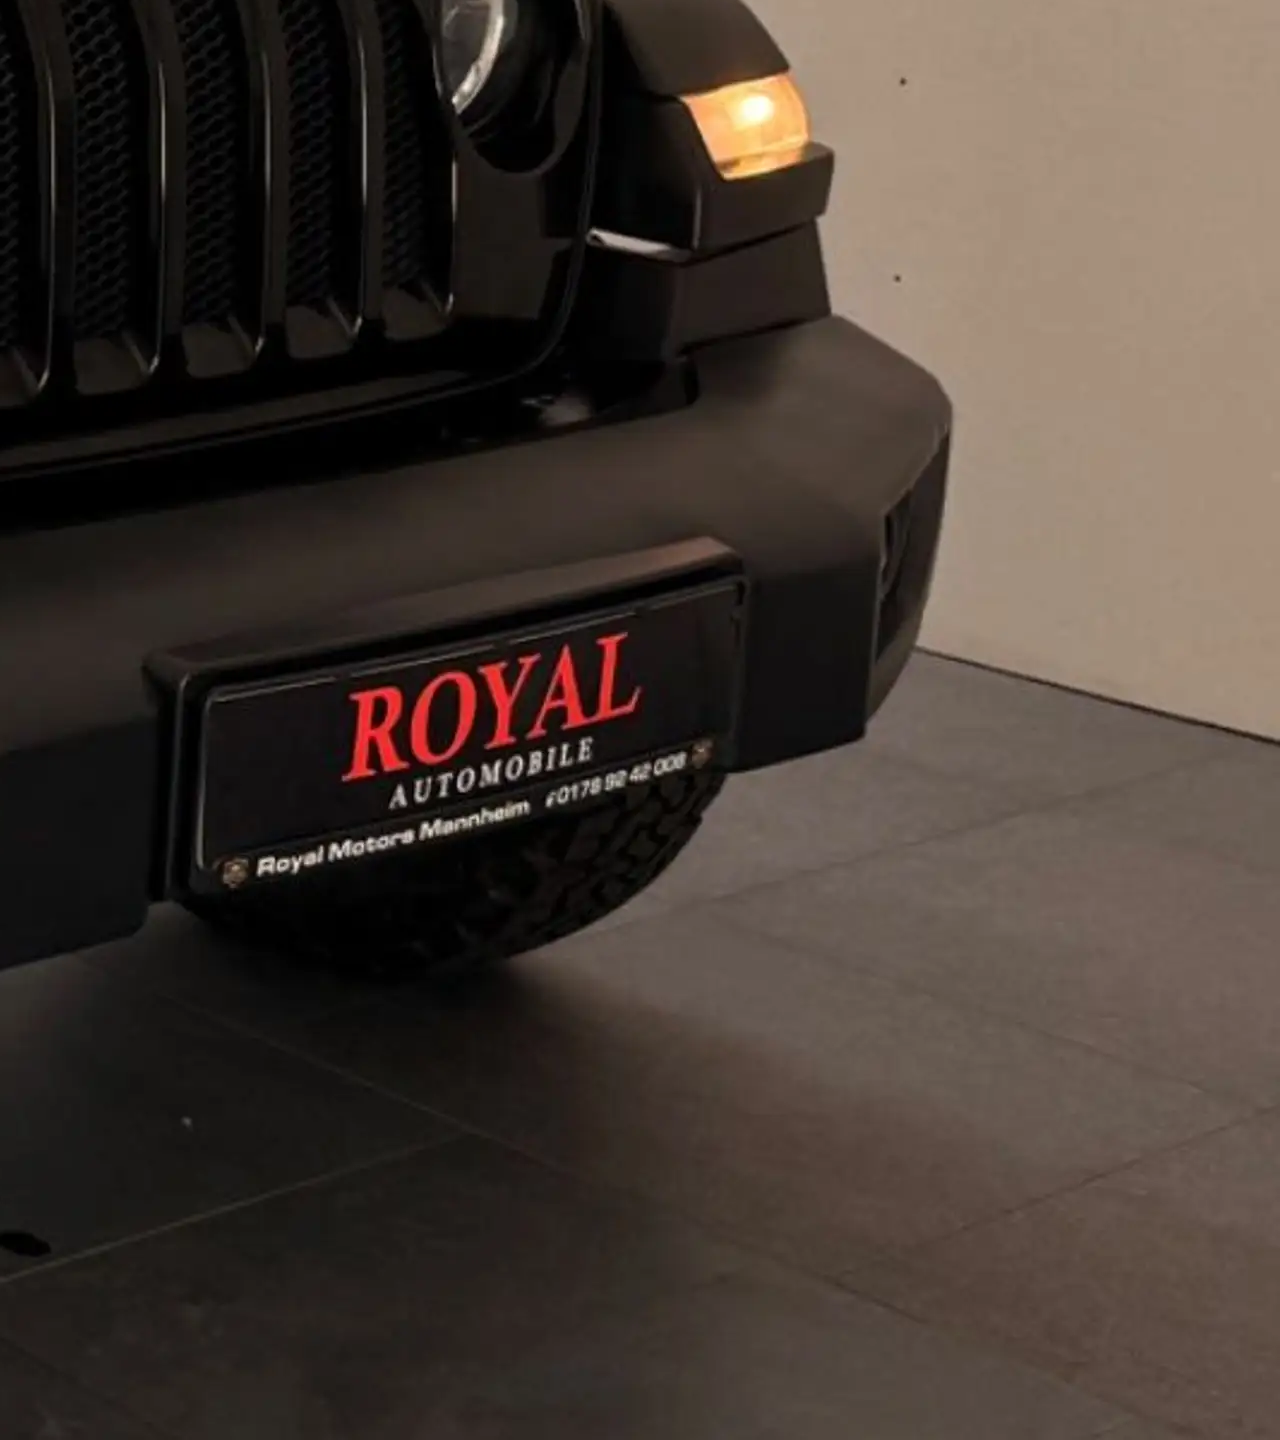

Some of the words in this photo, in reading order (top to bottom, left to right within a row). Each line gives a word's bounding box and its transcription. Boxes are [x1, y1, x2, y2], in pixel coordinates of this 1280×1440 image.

[341, 631, 641, 782] ROYAL
[388, 736, 594, 810] AUTOMOBILE
[256, 845, 324, 877] Royal
[328, 827, 415, 861] Motors
[419, 799, 531, 841] Mannheim
